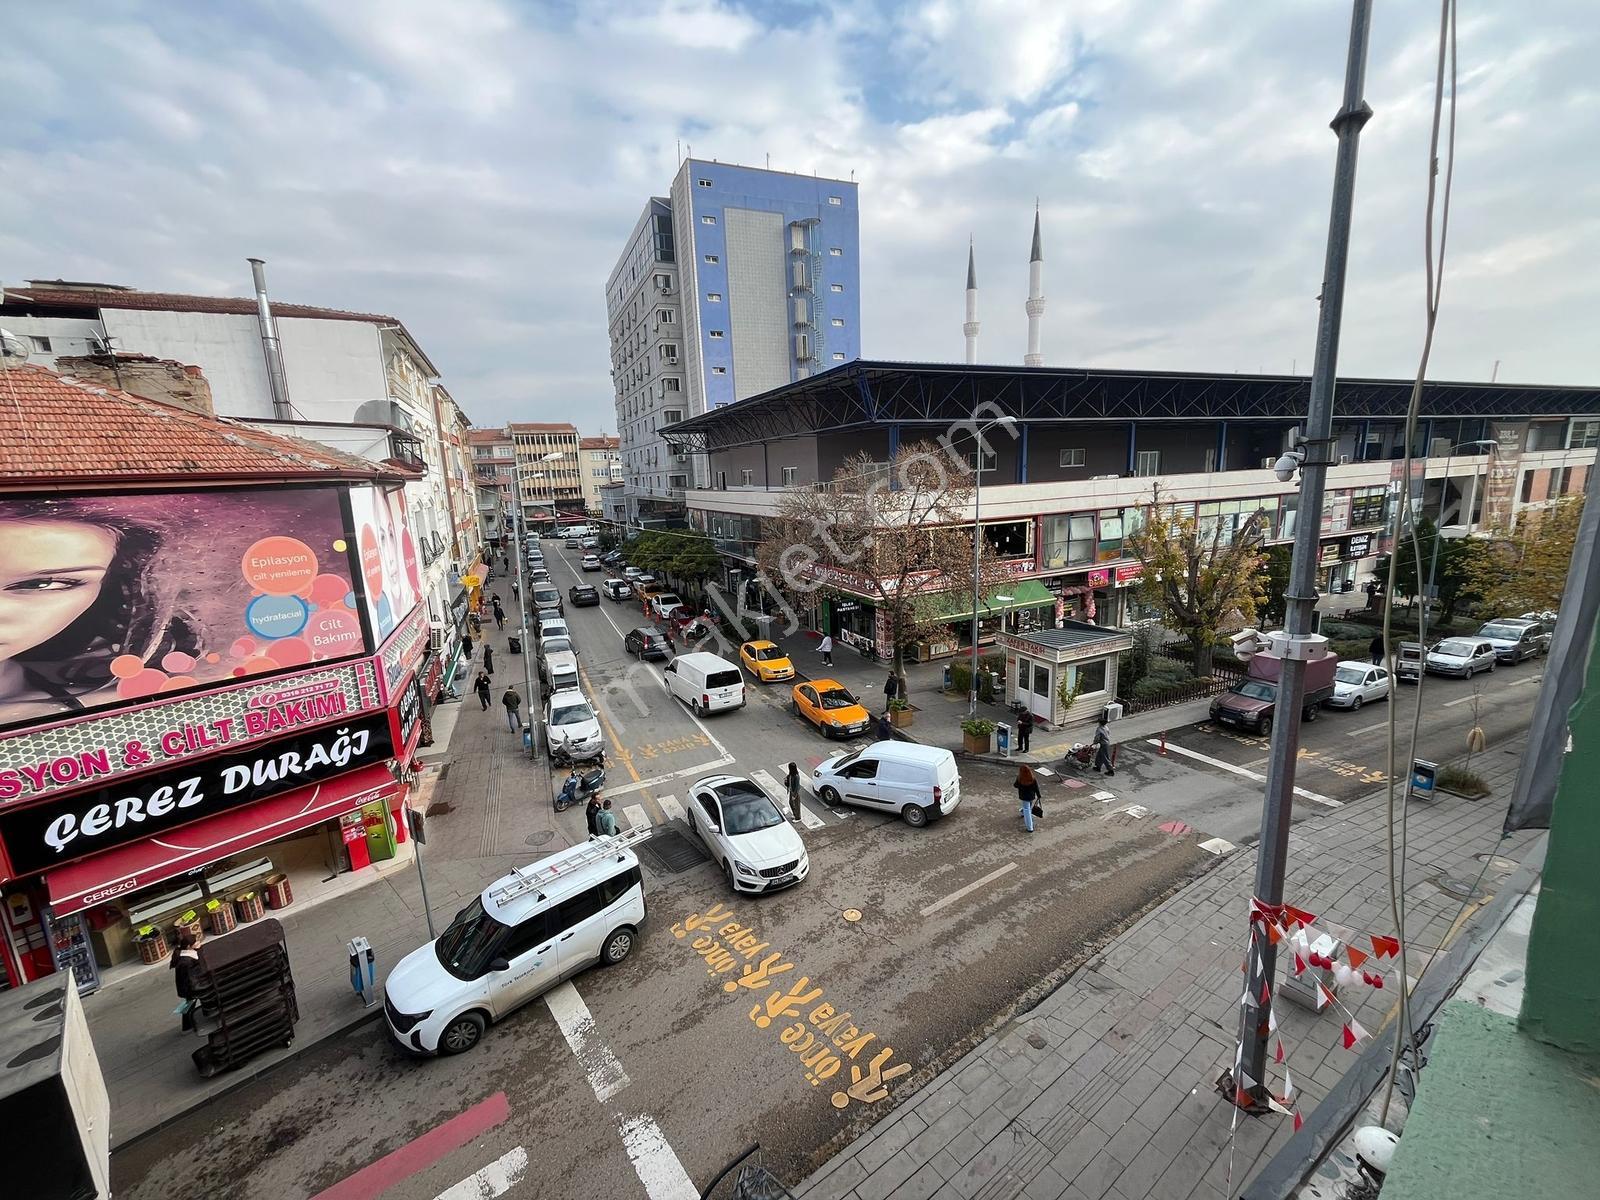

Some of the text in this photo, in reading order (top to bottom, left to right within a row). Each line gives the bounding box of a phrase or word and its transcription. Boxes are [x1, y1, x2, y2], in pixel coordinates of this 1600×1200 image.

[251, 552, 308, 568] Epilasyon
[253, 567, 312, 582] cilt yenileme
[252, 609, 303, 625] hydrafacial
[319, 619, 344, 632] Cilt
[313, 630, 357, 647] Bakımı
[123, 740, 151, 766] &
[161, 718, 234, 756] CİLT
[243, 691, 348, 736] BAKIMI
[44, 727, 370, 853] ÇEREZ DURAĞI
[779, 1022, 842, 1087] önce
